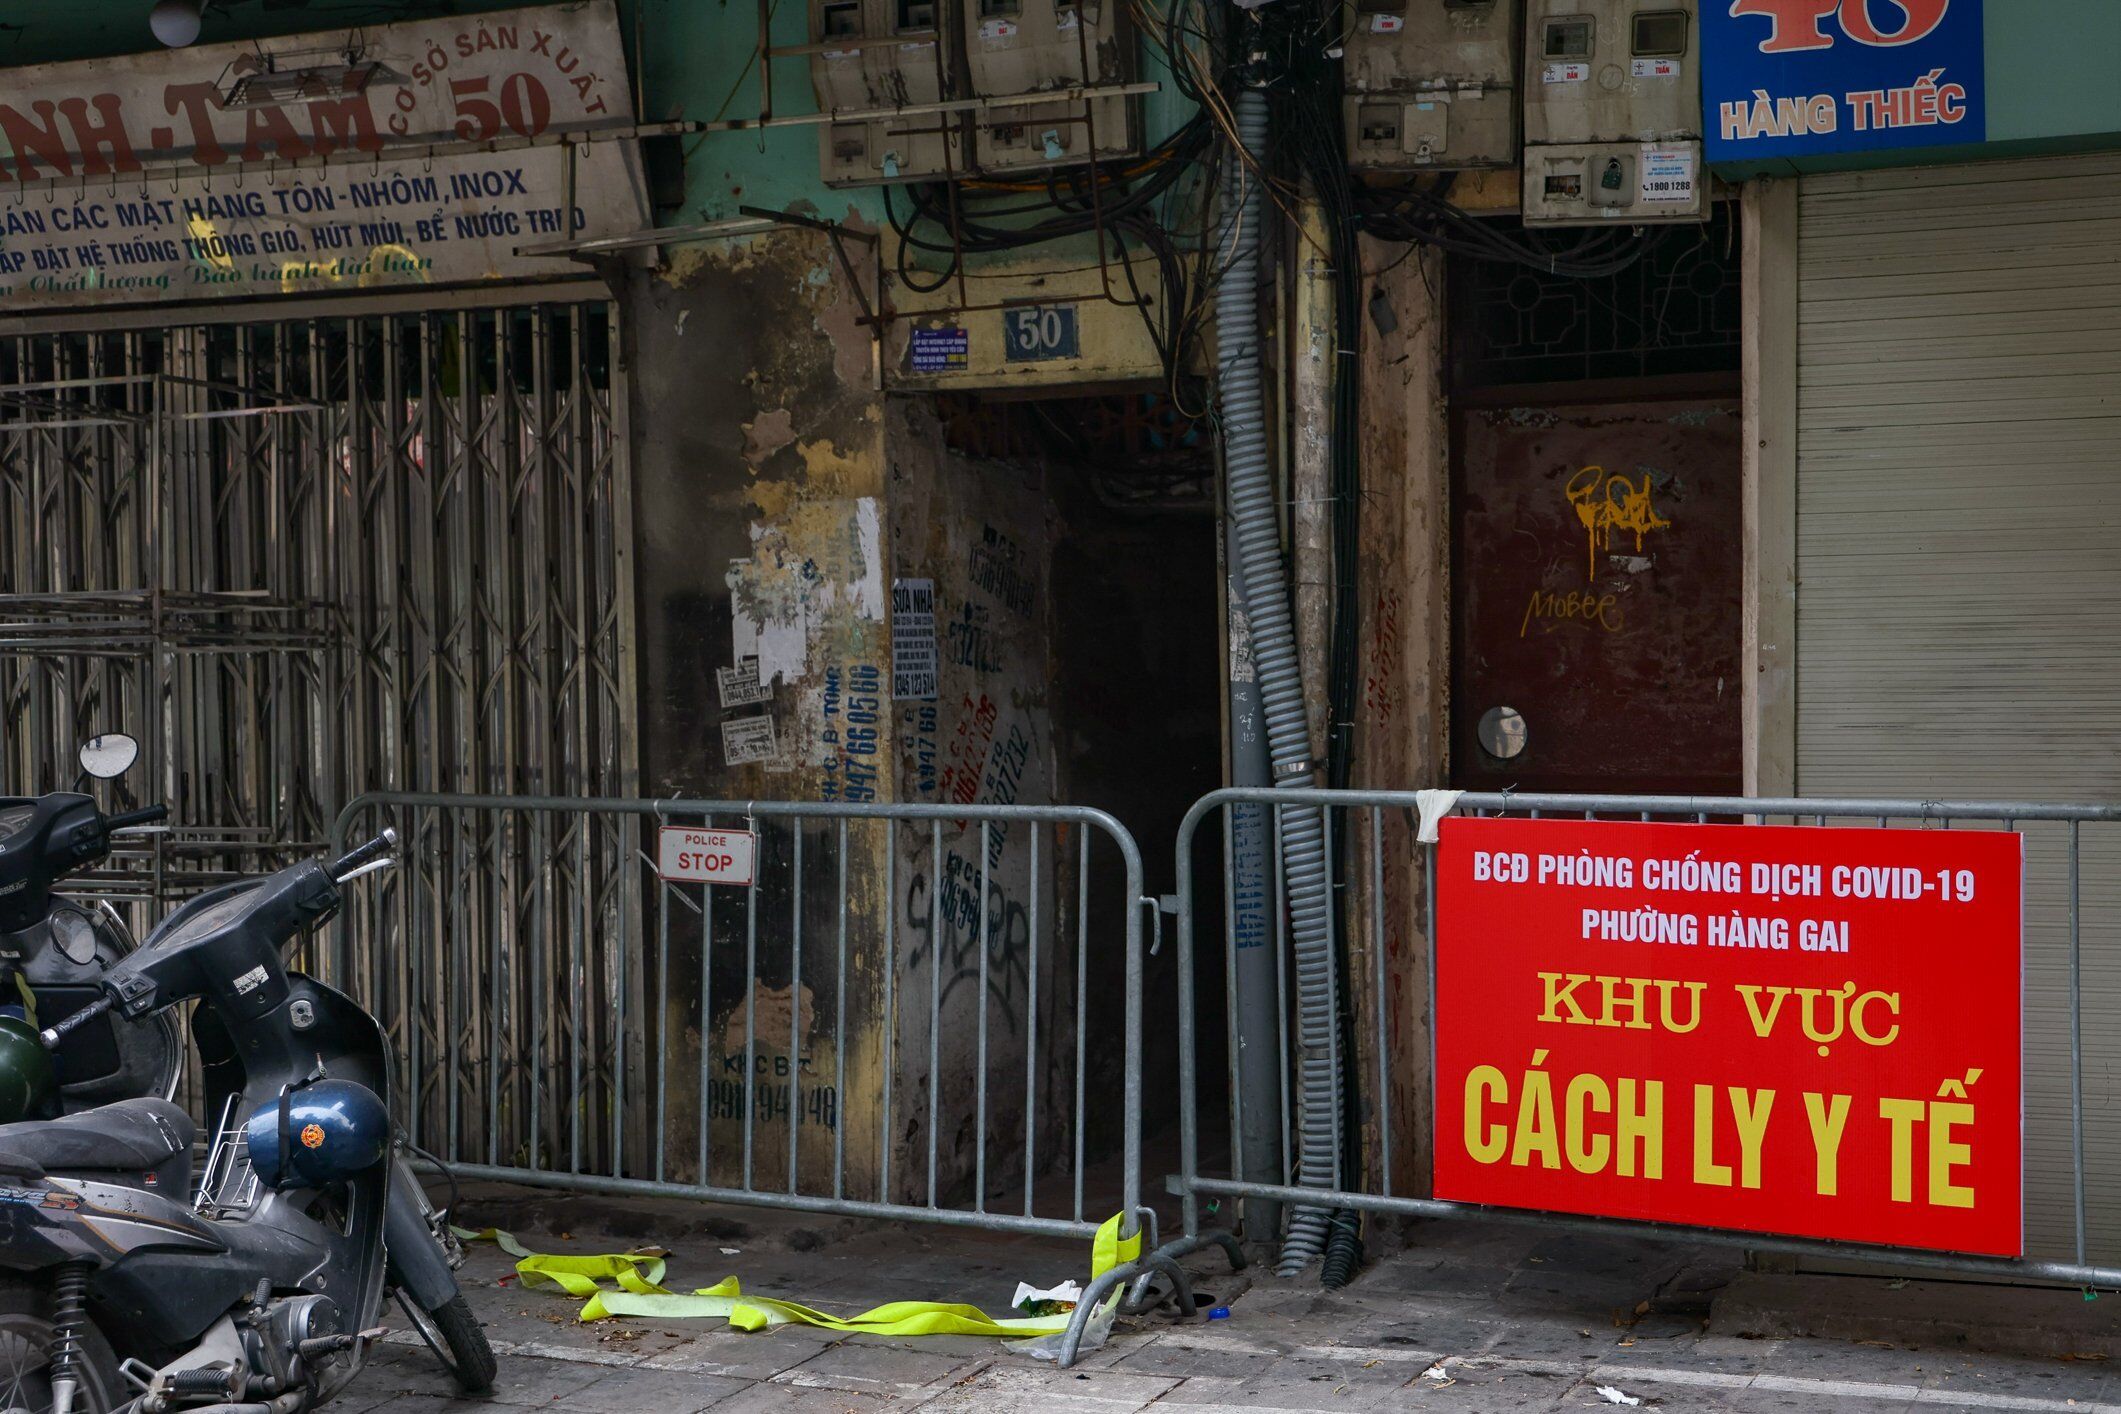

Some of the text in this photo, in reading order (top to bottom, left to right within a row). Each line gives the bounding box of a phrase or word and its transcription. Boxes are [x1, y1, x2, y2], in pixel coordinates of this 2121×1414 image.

[455, 19, 518, 57] SẢN
[530, 30, 607, 114] XUẤT
[449, 72, 551, 142] 50
[1720, 67, 1966, 140] HÀNG THIẾC
[32, 242, 72, 271] ĐẶT
[77, 239, 107, 267] HỆ
[107, 233, 179, 265] THỐNG
[182, 230, 257, 260] THÔNG
[311, 220, 352, 250] HÚT
[416, 207, 448, 242] BỂ
[455, 205, 520, 239] NƯỚC
[51, 201, 110, 232] CÁC
[115, 193, 174, 232] MẶT
[1018, 310, 1062, 350] 50
[913, 583, 933, 613] NHÀ
[678, 852, 733, 872] STOP
[685, 834, 727, 847] POLICE
[1474, 848, 1975, 902] BCĐ PHÒNG CHỐNG DỊCH COVID-19
[1582, 904, 1850, 953] PHƯỜNG HÀNG GAI
[1537, 971, 1900, 1058] KHU VỰC
[1464, 1048, 1984, 1209] CÁCH LY Y TẾ
